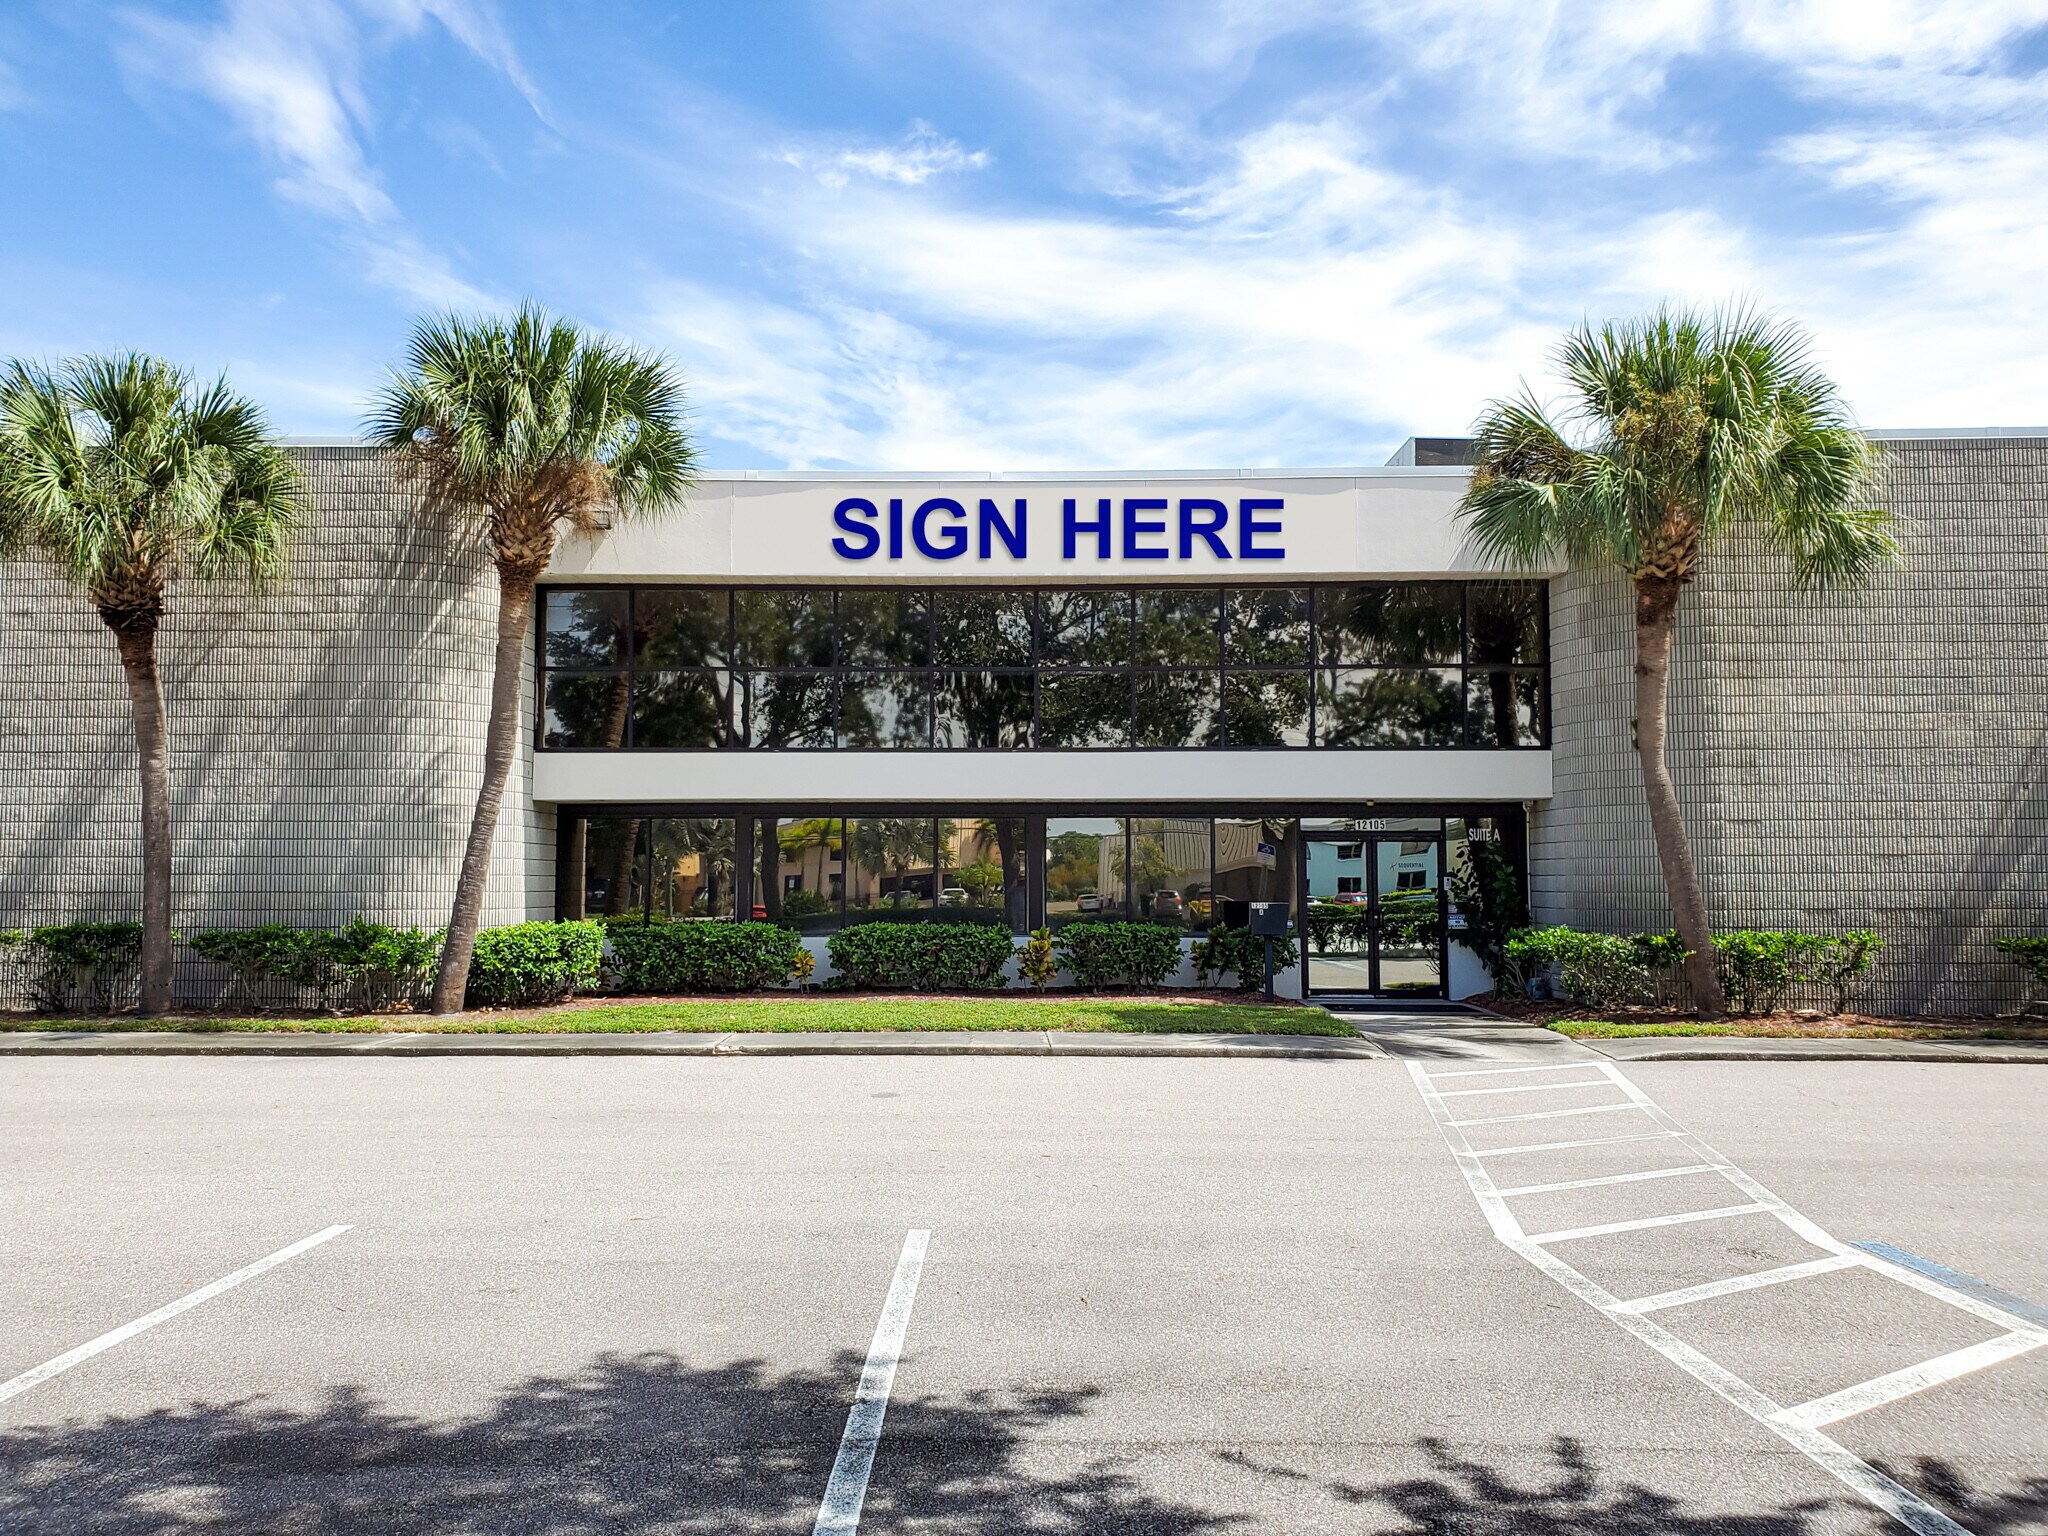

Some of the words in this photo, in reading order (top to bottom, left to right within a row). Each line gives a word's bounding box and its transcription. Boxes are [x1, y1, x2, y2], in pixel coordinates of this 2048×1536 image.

[1356, 820, 1385, 830] 12105
[1468, 828, 1492, 841] SUITE
[1493, 828, 1501, 841] A
